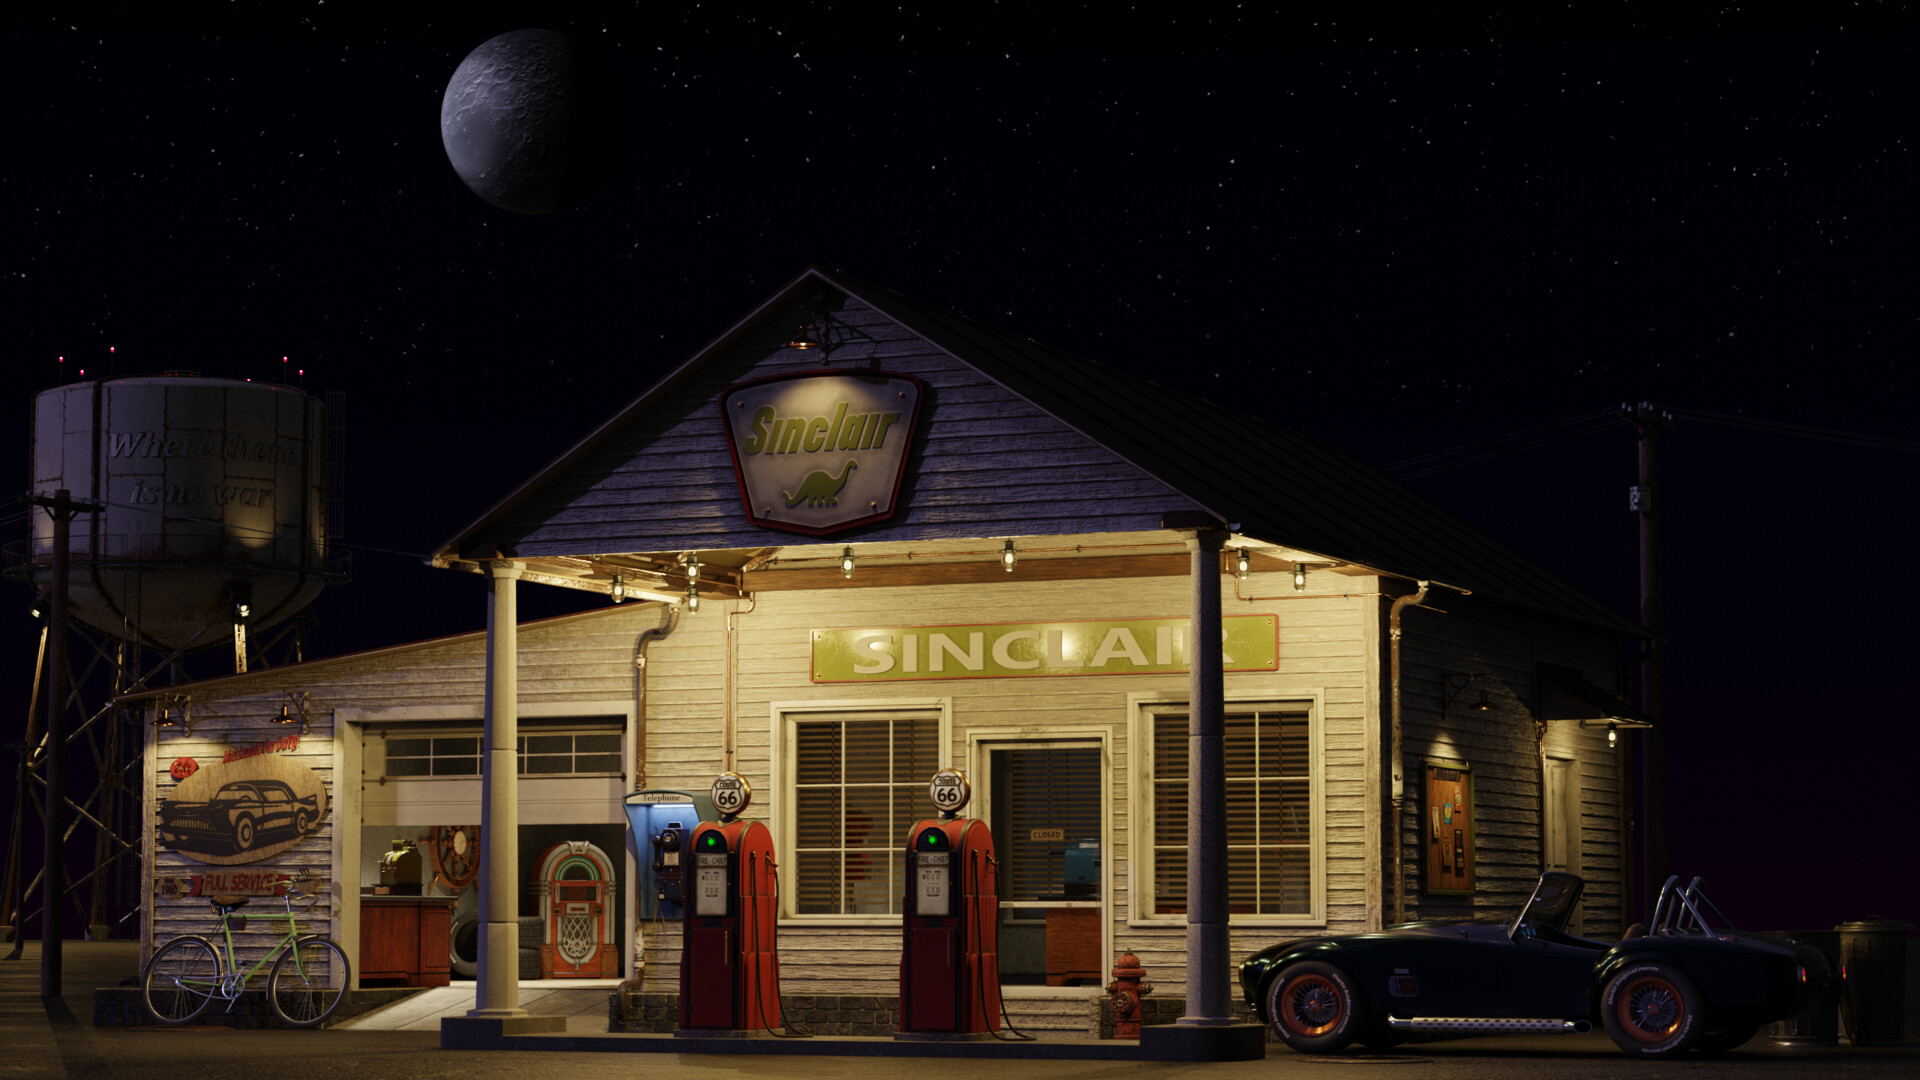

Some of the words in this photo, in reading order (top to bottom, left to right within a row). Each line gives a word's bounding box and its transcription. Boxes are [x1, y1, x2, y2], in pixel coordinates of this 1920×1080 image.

[743, 401, 901, 456] Sinclair
[109, 431, 216, 458] Where
[223, 433, 298, 465] there
[131, 480, 163, 505] is
[166, 482, 206, 505] no
[215, 482, 275, 509] war
[263, 738, 276, 753] On
[276, 732, 300, 751] Duty!
[643, 795, 681, 803] Telephone
[718, 791, 738, 805] 66
[937, 788, 958, 802] 66
[1033, 831, 1061, 839] CLOSED
[205, 875, 228, 890] FULL
[231, 874, 273, 891] SERVICE
